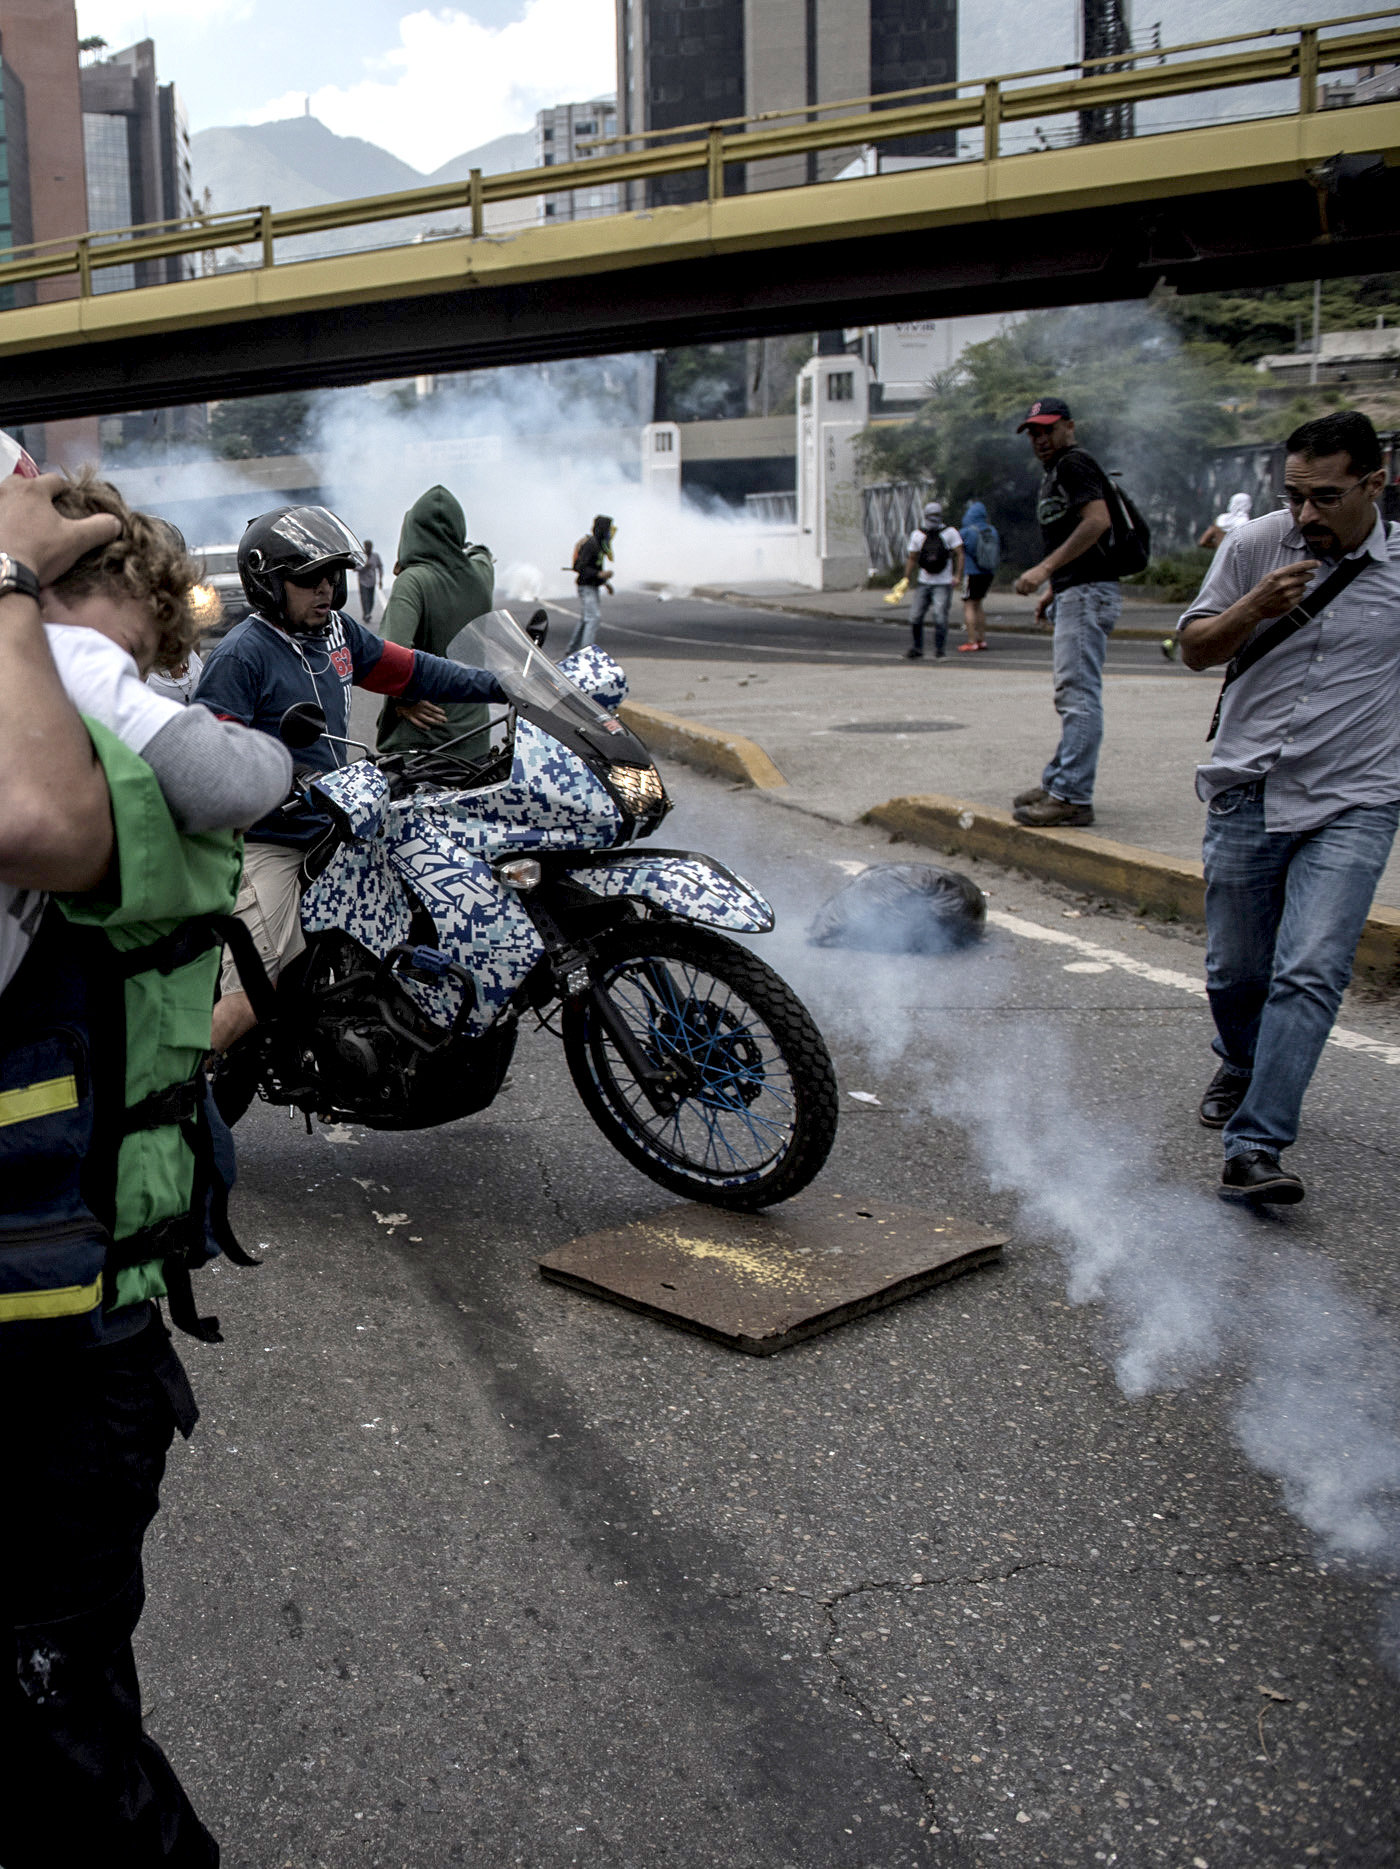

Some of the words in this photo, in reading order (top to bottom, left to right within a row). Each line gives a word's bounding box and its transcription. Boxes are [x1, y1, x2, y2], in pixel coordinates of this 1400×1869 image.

[330, 646, 354, 678] 62
[390, 853, 419, 879] 650
[394, 837, 497, 916] KLR
